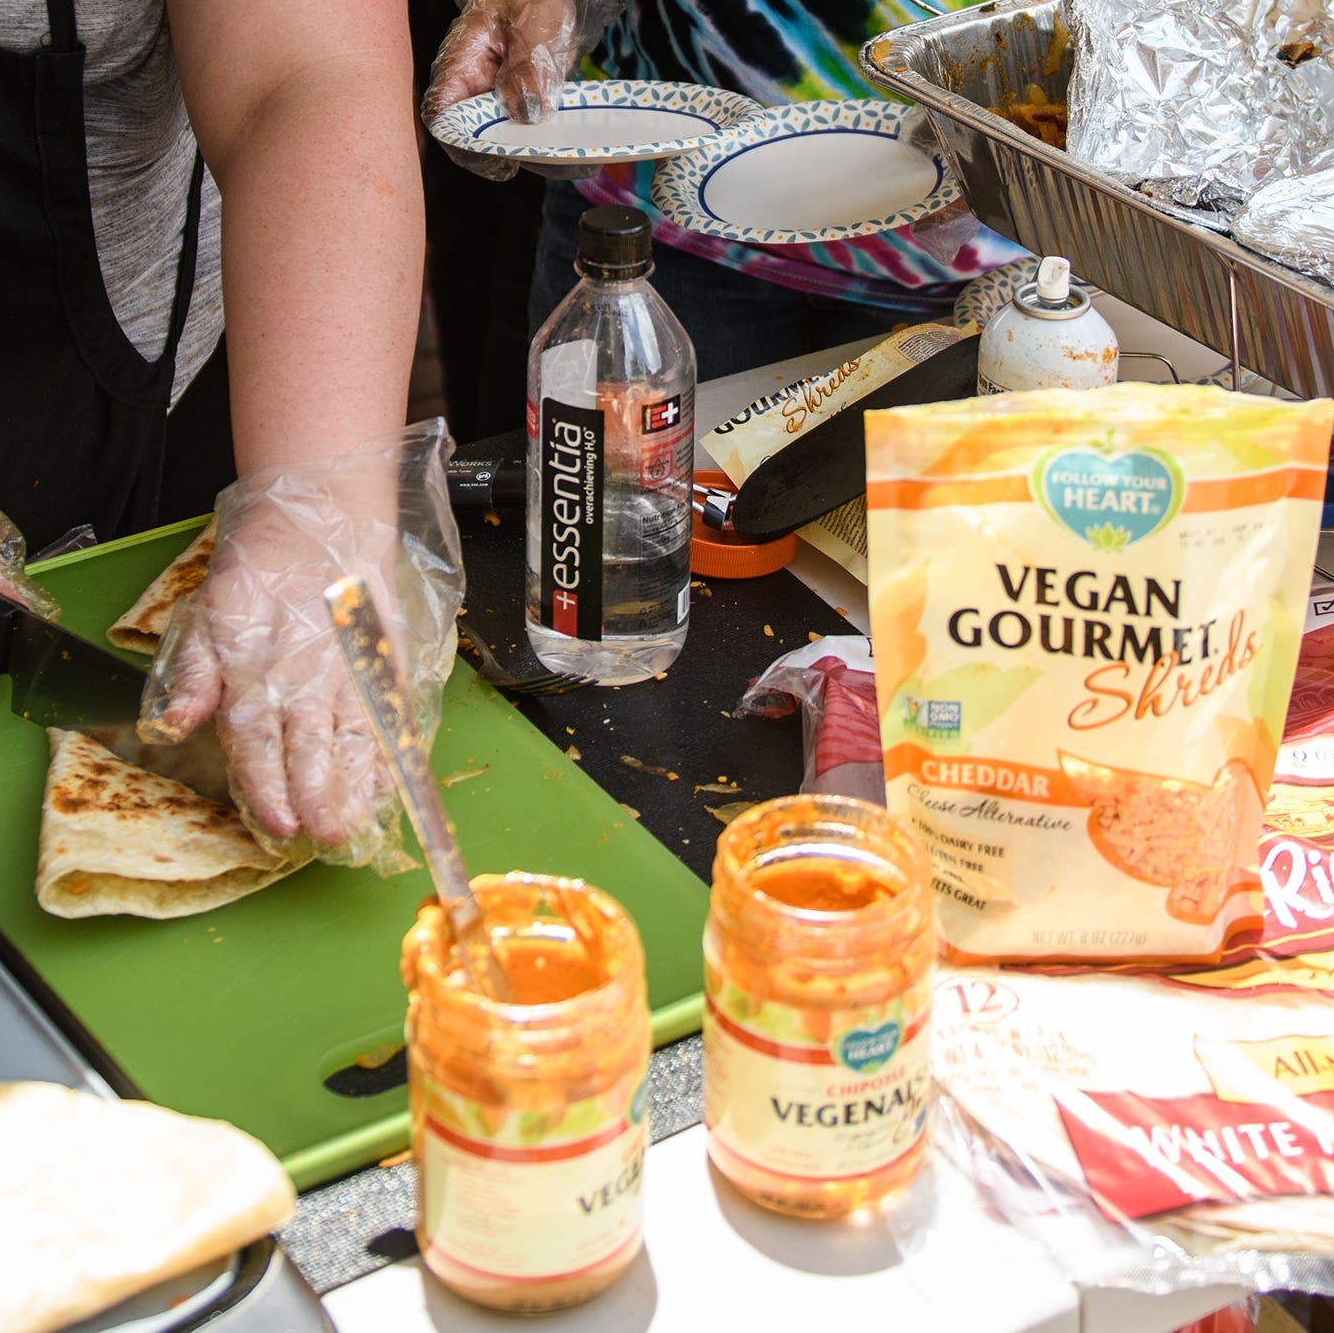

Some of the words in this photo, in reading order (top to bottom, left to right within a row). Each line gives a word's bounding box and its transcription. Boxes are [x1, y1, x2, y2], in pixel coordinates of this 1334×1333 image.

[781, 357, 862, 434] Shreds
[583, 455, 595, 525] overachieving
[1051, 470, 1120, 487] FOLLOW
[1122, 472, 1168, 491] YOUR
[1063, 487, 1156, 516] HEART
[995, 563, 1183, 618] VEGAN
[948, 608, 1218, 668] GOURMET
[1067, 608, 1259, 732] Shreds
[921, 759, 1050, 798] CHEDDAR
[906, 783, 957, 813] Cheese
[959, 798, 1073, 832] Alternative
[939, 834, 974, 852] DAIRY
[977, 844, 1005, 859] FREE
[959, 858, 984, 873] FREE
[930, 876, 953, 897] ELTS
[953, 886, 987, 911] GREAT
[1090, 930, 1108, 945] OZ
[946, 980, 1004, 1014] 12
[1131, 1122, 1302, 1164] WHITE
